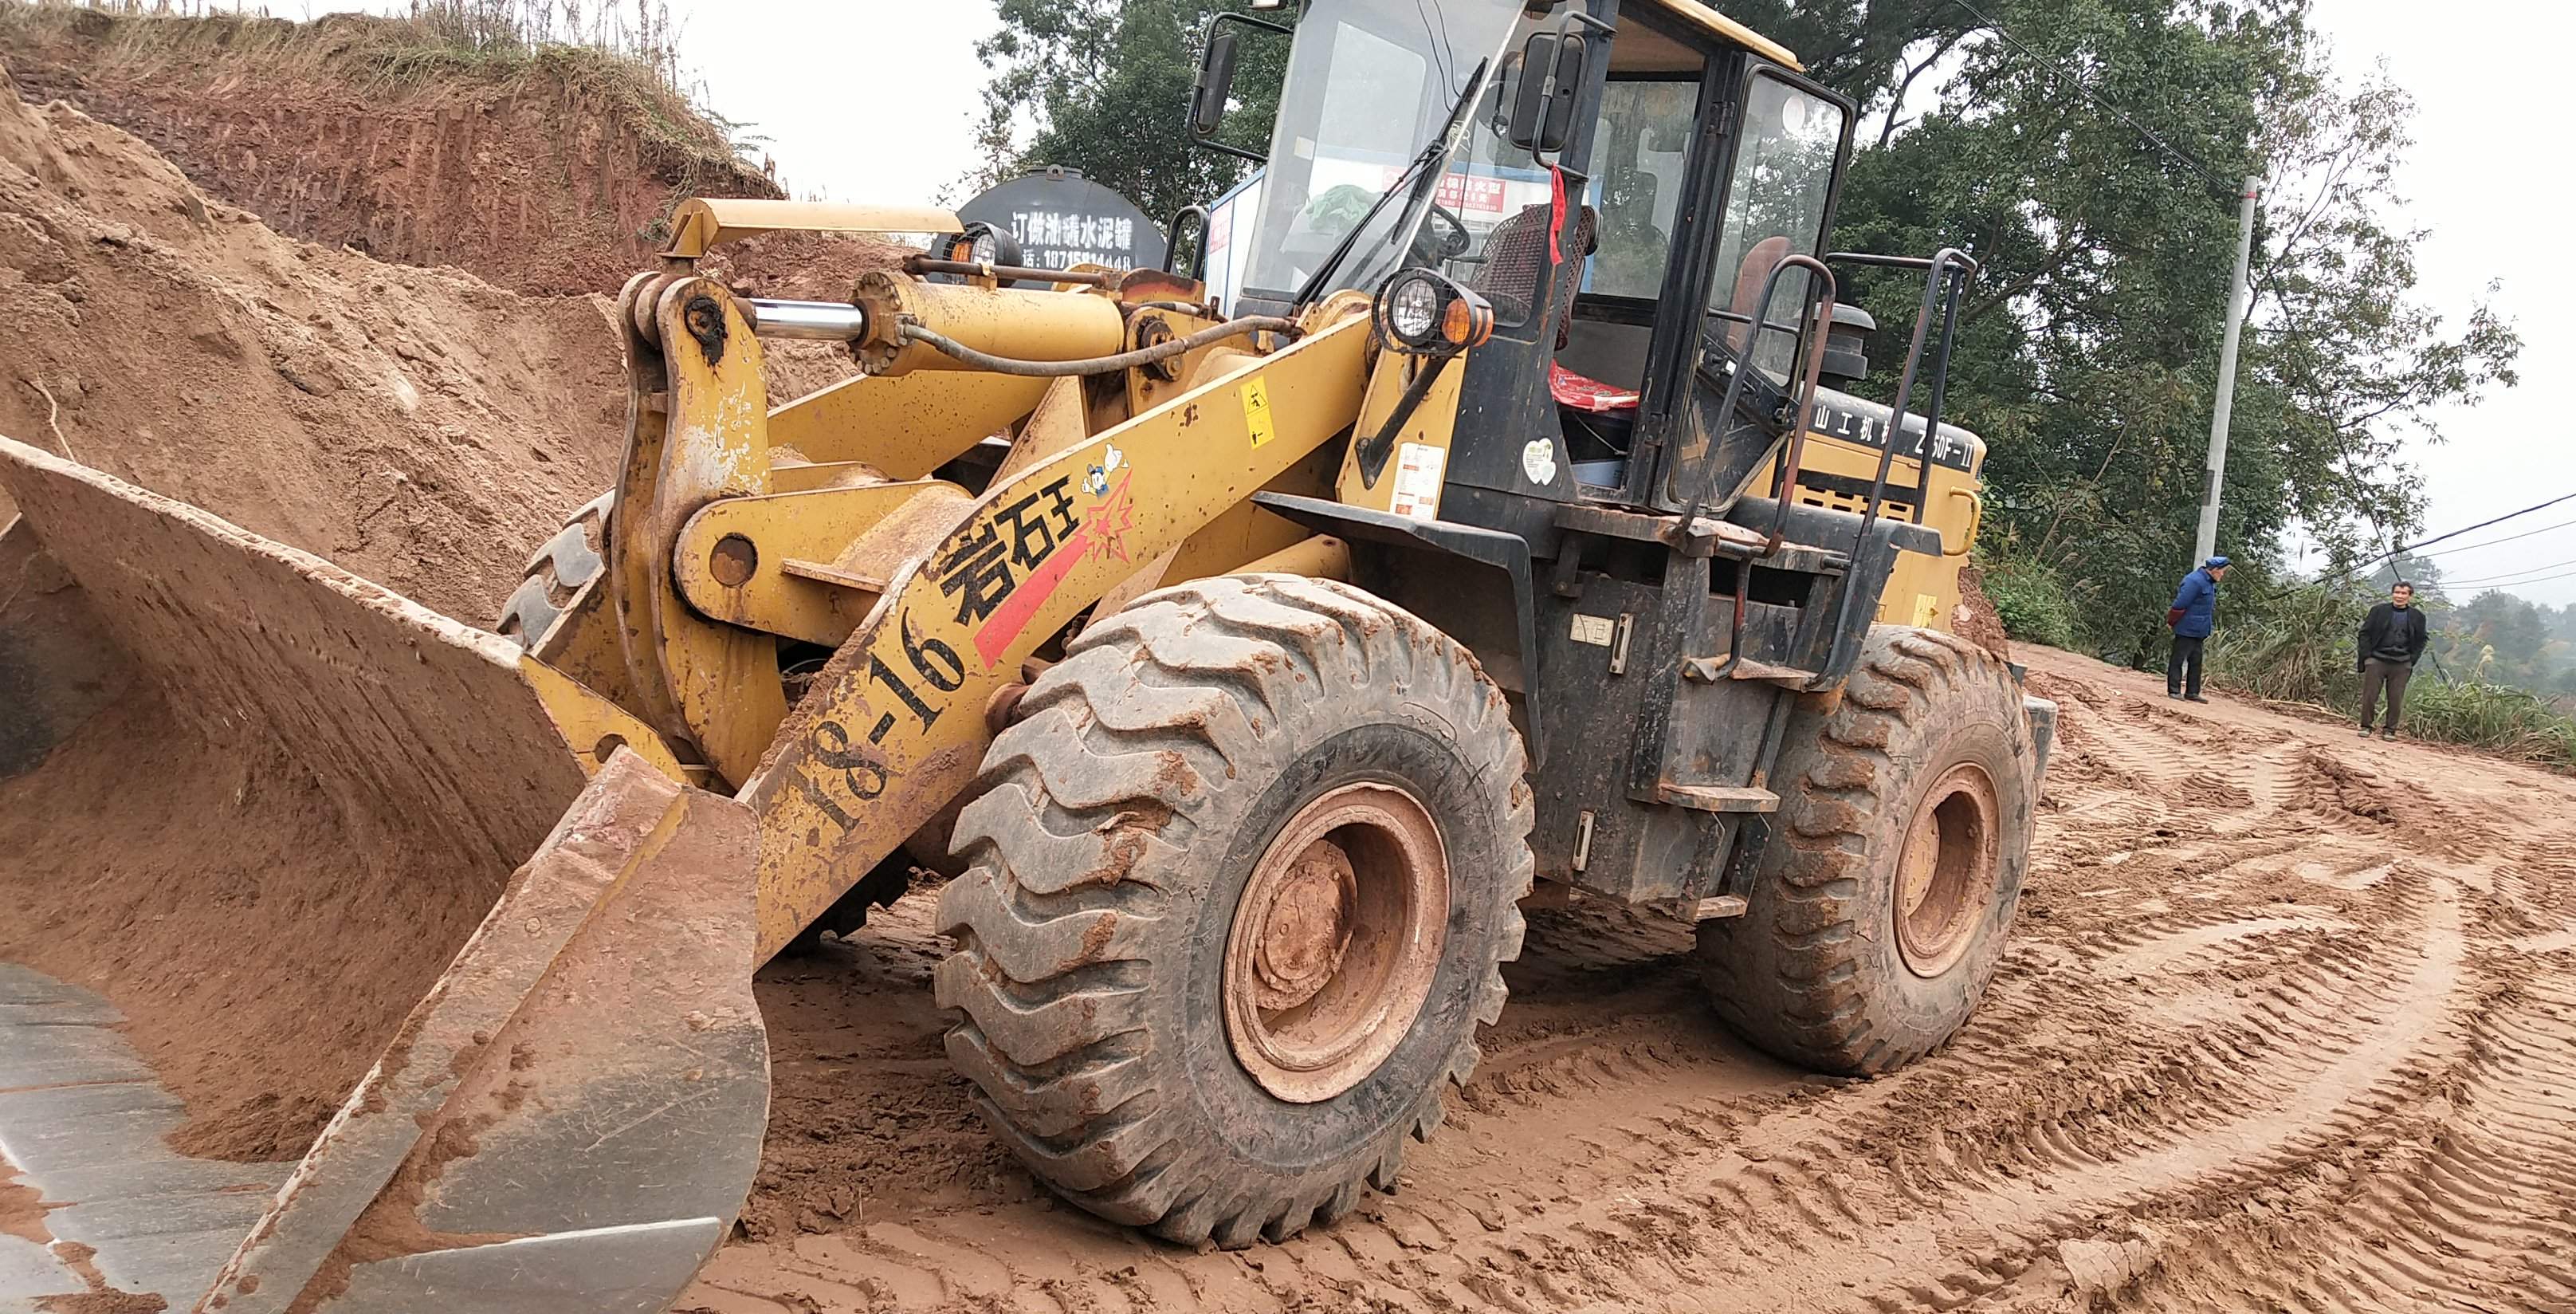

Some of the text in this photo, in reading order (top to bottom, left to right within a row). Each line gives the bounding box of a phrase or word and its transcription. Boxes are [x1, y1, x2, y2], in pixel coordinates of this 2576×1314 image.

[1011, 212, 1133, 250] 订做油罐水泥罐
[1914, 430, 1974, 468] Z50F-II
[940, 474, 1080, 626] 岩石王
[788, 606, 966, 838] 18-16
